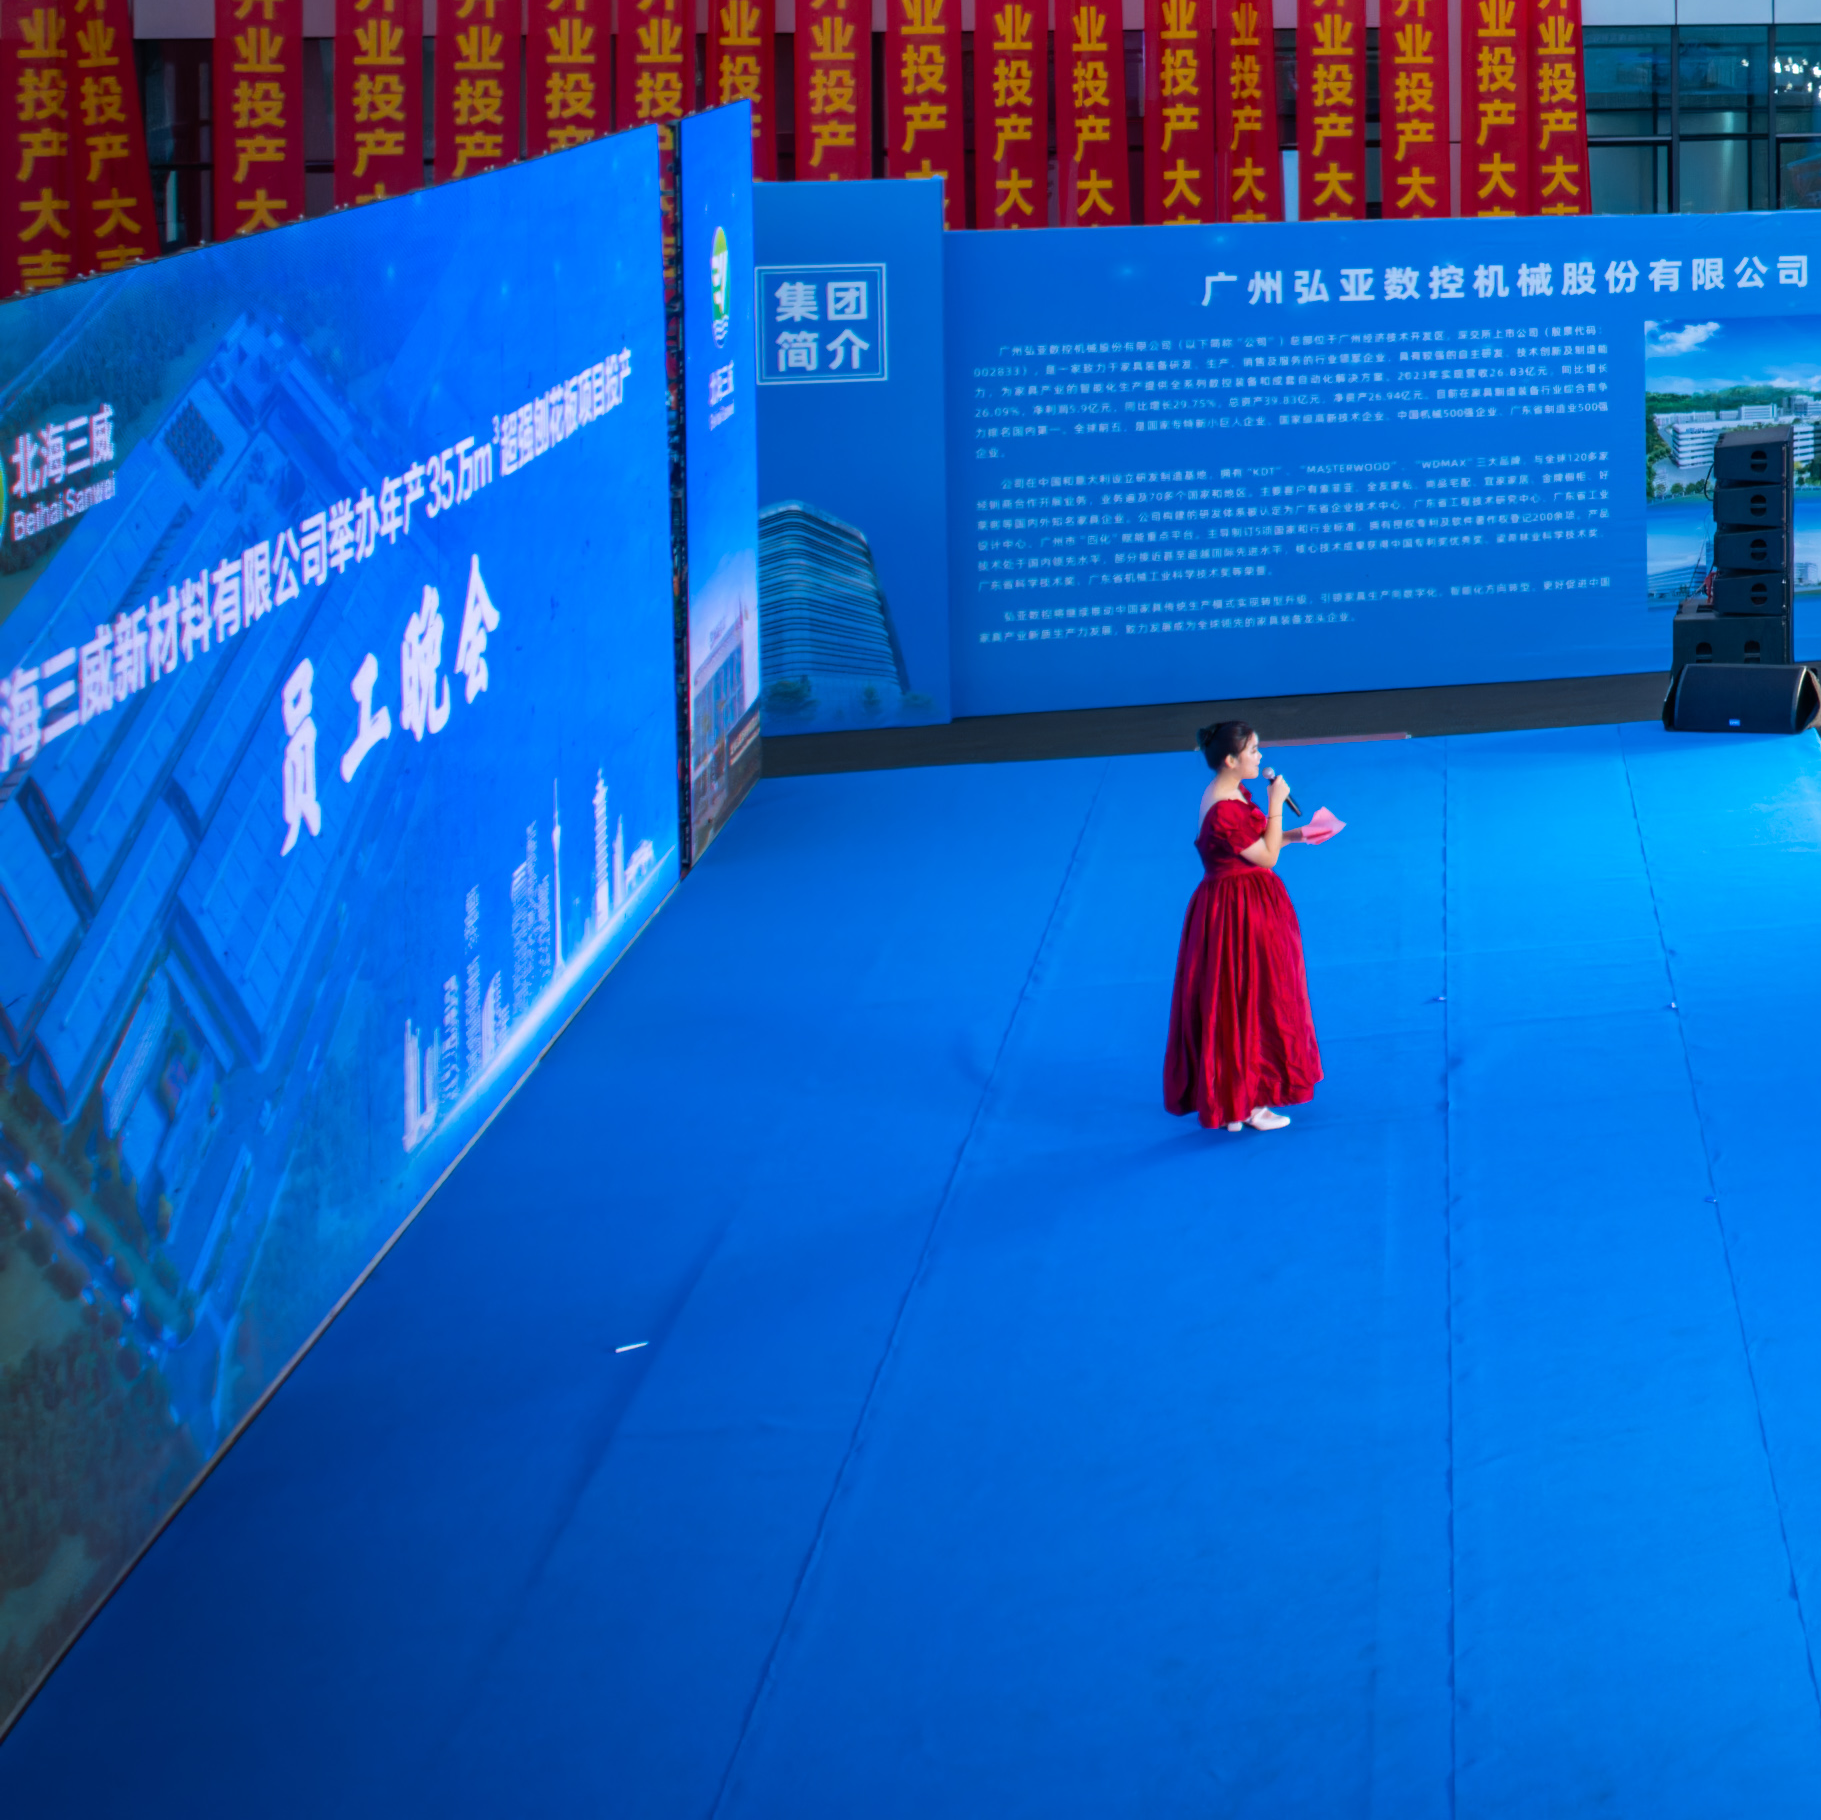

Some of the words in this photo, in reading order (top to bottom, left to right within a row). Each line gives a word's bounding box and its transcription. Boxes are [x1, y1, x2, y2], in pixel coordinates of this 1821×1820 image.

[774, 280, 869, 323] 集团
[1201, 253, 1809, 307] 广州弘亚数控机械股份有限公司
[775, 329, 870, 373] 简介
[11, 402, 116, 499] 北海三威
[13, 491, 64, 541] Beihai
[64, 471, 117, 518] Sanwei
[280, 552, 501, 858] 员工晚会
